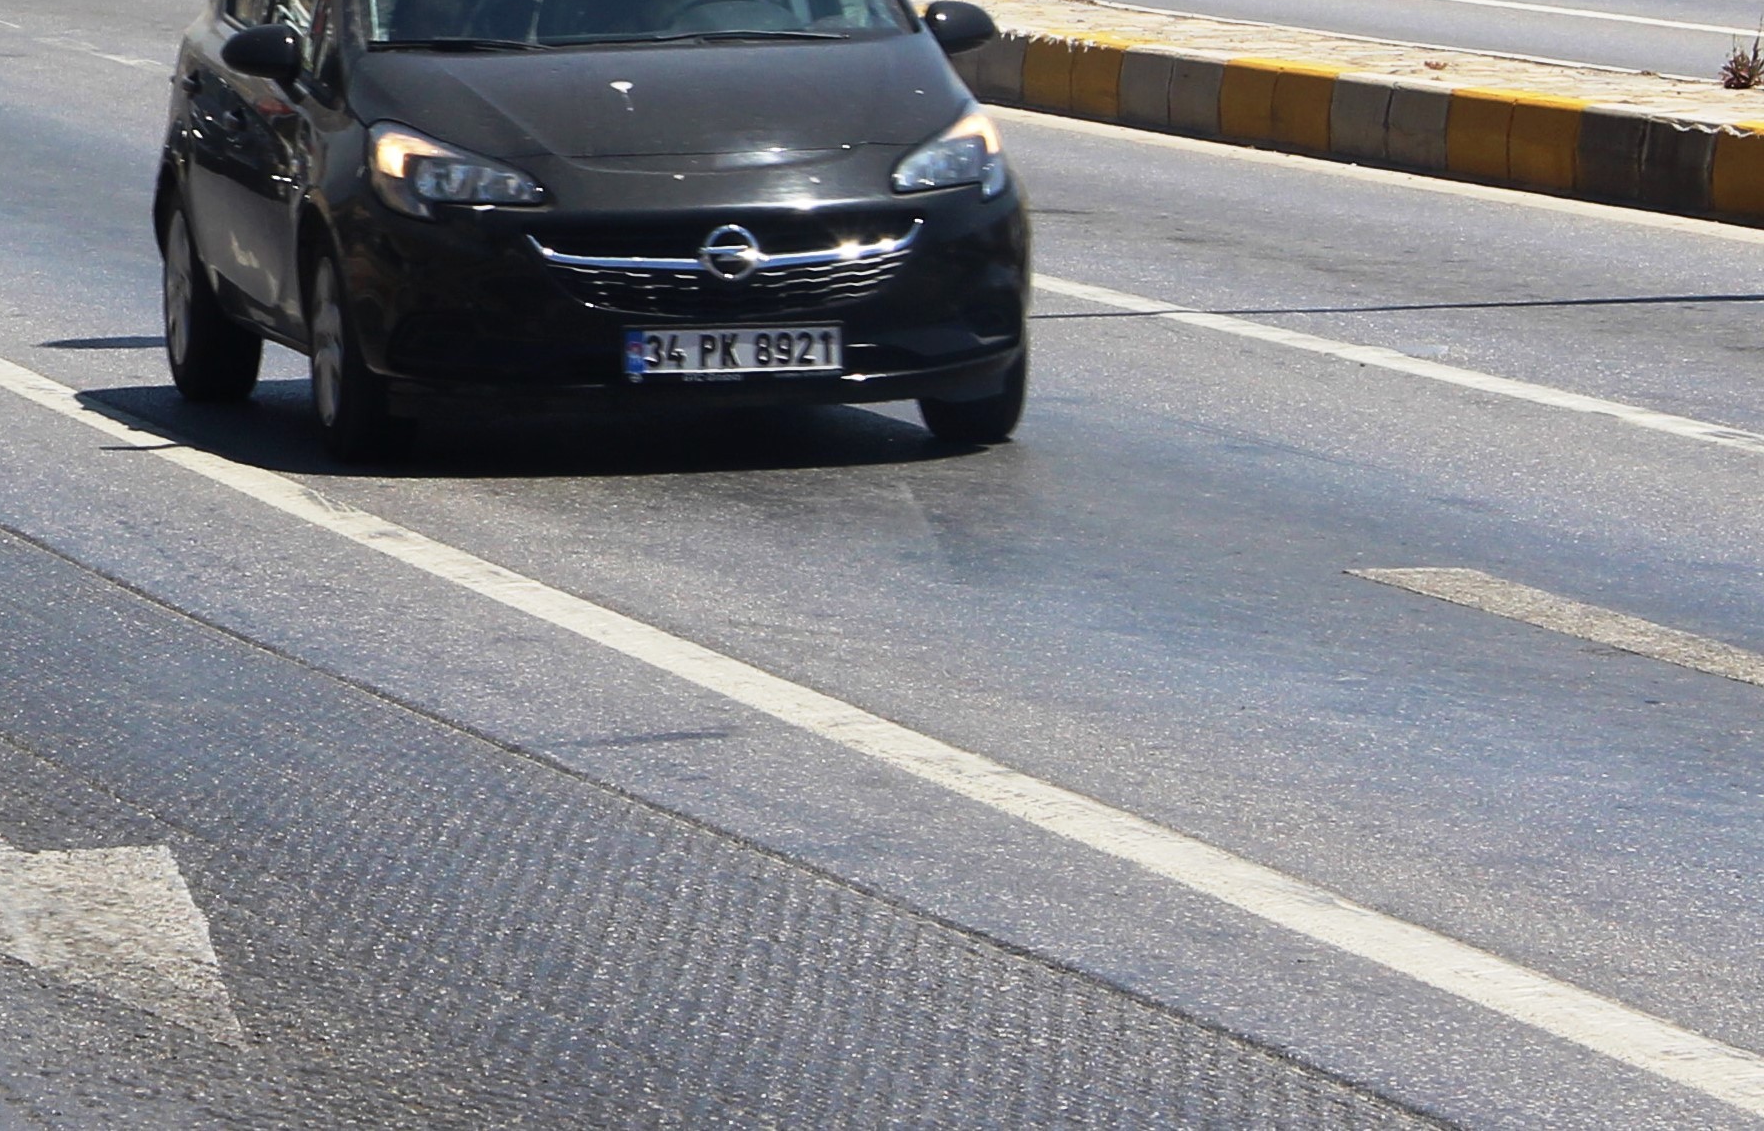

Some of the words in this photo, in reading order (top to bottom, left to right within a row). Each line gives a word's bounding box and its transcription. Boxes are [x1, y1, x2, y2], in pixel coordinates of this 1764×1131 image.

[644, 334, 686, 367] 34
[699, 333, 740, 367] PK
[754, 331, 835, 366] 8921
